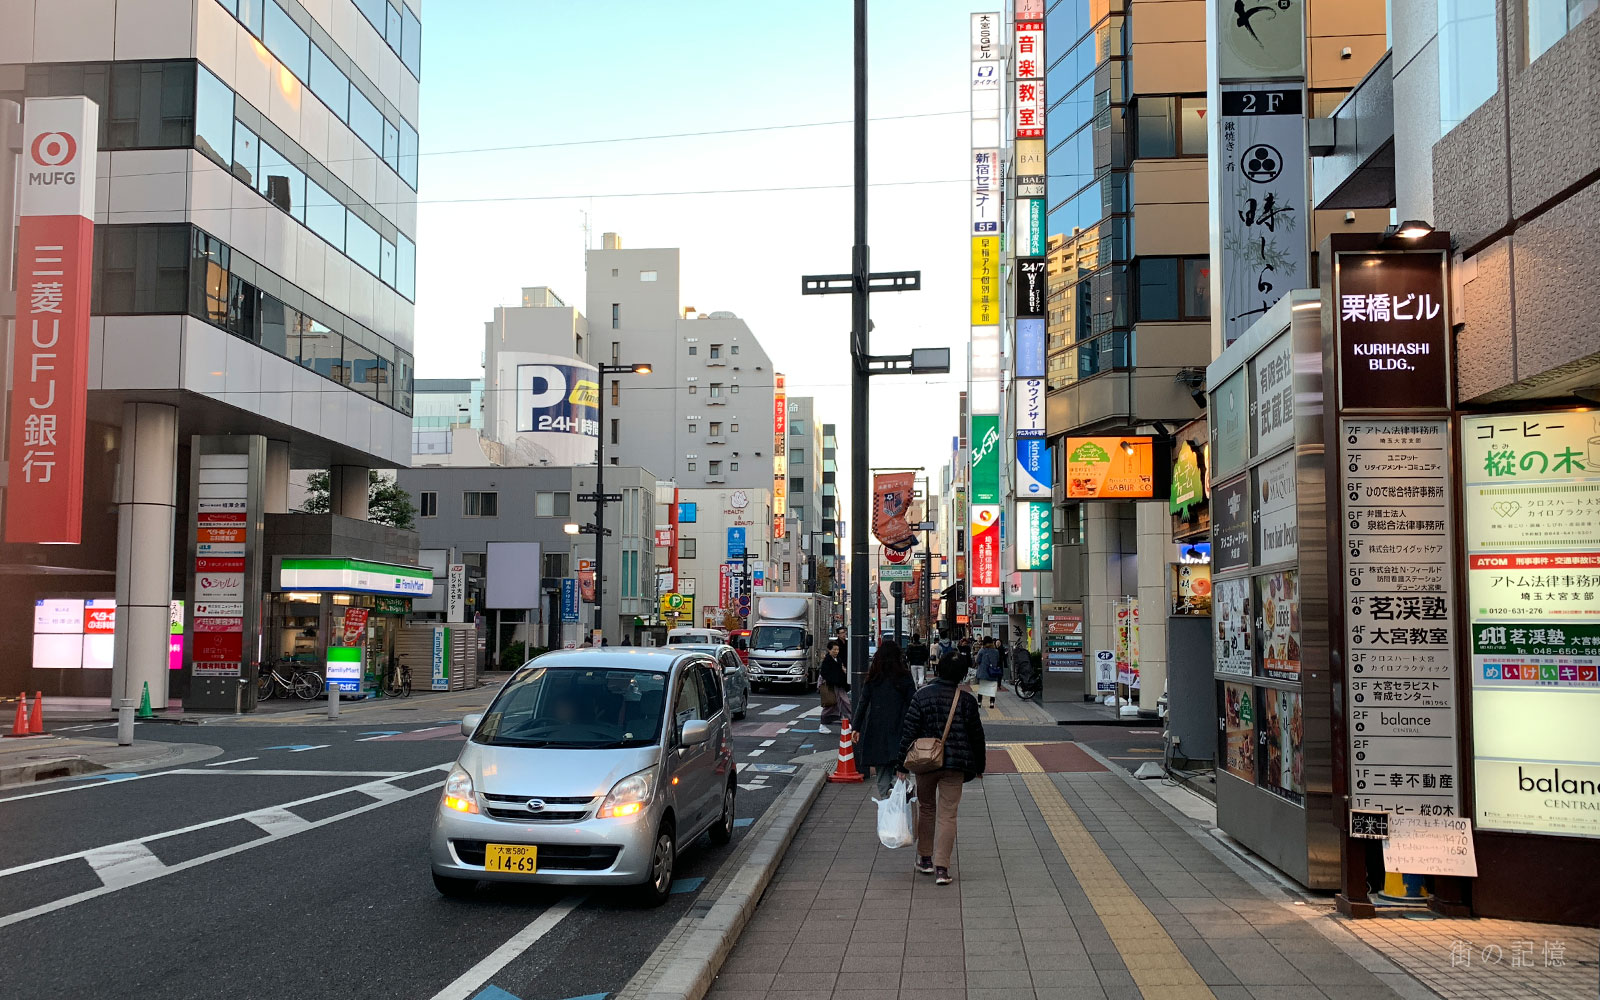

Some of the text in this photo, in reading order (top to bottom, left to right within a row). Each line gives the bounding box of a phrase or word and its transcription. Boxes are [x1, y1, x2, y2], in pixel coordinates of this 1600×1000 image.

[1018, 35, 1035, 126] 音楽教室
[1242, 92, 1284, 113] 2F
[29, 172, 76, 186] MUFG
[975, 152, 990, 218] 新宿セミナー
[979, 223, 993, 231] 5F
[1021, 263, 1045, 272] 24/7
[1027, 272, 1037, 312] Workout
[1341, 293, 1440, 322] 栗橋ビル
[1354, 343, 1430, 355] KURIHASHI
[22, 245, 64, 483] 三菱UFJ銀行
[1259, 348, 1291, 394] 有限会社
[517, 365, 567, 431] P
[1028, 387, 1039, 428] ウインザー
[1261, 384, 1293, 437] 武蔵屋
[776, 401, 784, 429] カラオケ
[538, 415, 578, 432] 24H
[1347, 426, 1361, 435] 7F
[1365, 426, 1438, 435] アトム法律事務所
[1477, 421, 1565, 439] コーヒー
[972, 426, 999, 468] エイブル
[1031, 441, 1040, 472] kinko's
[1347, 454, 1362, 463] 7F
[1347, 482, 1362, 491] 6F
[1366, 486, 1444, 498] ひので総合特許事務所
[1348, 511, 1363, 520] 6F
[1367, 509, 1406, 518] 弁護士法人
[1367, 520, 1444, 531] 泉総合法律事務所
[1348, 540, 1364, 549] 5F
[1368, 545, 1443, 554] 株式会社ワイグッドケア
[1477, 558, 1508, 566] ATOM
[1349, 568, 1364, 577] 5F
[401, 578, 424, 591] FamilyMart
[1490, 574, 1600, 588] アトム法律事務所
[1351, 596, 1366, 605] 4F
[1520, 591, 1594, 601] 埼玉大宮支部
[1369, 596, 1448, 621] 茗渓塾
[1352, 625, 1366, 634] 4F
[1370, 627, 1448, 645] 大宮教室
[1509, 628, 1566, 645] 茗渓塾
[435, 631, 443, 676] FamilyMart
[1351, 653, 1367, 662] 3F
[327, 666, 360, 675] FamilyMart
[339, 683, 357, 691] たばこ
[1352, 682, 1368, 691] 3F
[1372, 681, 1440, 691] 大宮セラピスト
[1373, 691, 1432, 701] 育成センター
[1353, 711, 1369, 720] 2F
[1380, 711, 1431, 726] balance
[1353, 740, 1369, 749] 2F
[1355, 769, 1370, 778] 1F
[1373, 773, 1453, 789] 二幸不動産
[1356, 798, 1371, 807] 1F
[498, 856, 534, 871] 14-69
